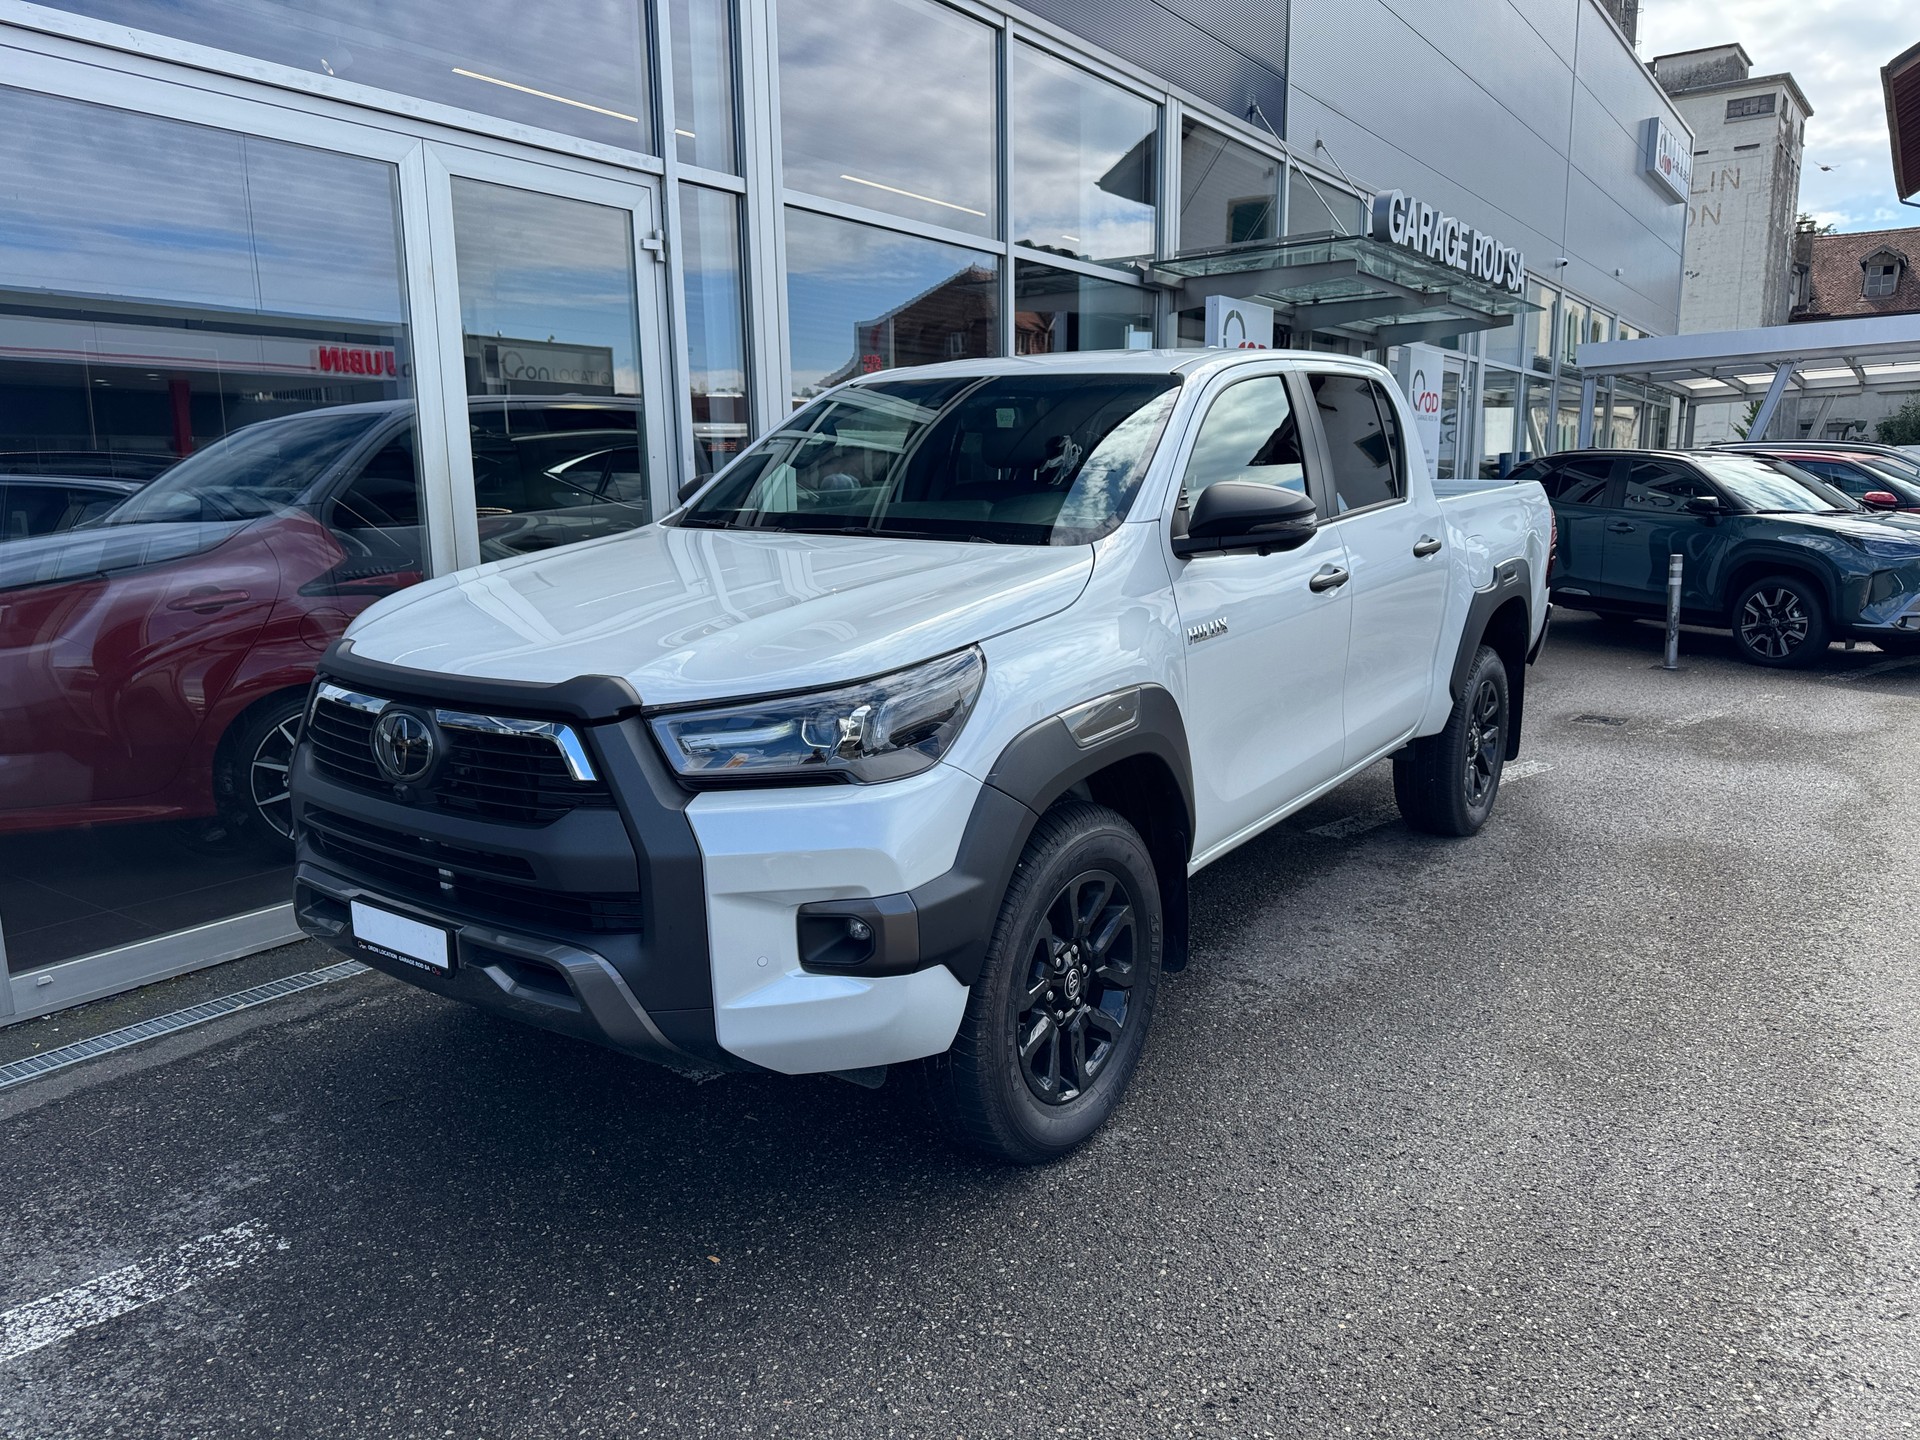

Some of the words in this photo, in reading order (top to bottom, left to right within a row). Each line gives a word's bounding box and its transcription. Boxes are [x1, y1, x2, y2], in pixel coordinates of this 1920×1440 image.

[1387, 188, 1470, 271] GARAGE
[1471, 229, 1506, 285] ROD
[1507, 248, 1525, 294] SA
[1187, 617, 1229, 646] HILUX
[379, 948, 398, 960] LOCATION
[398, 955, 415, 966] GARAGE
